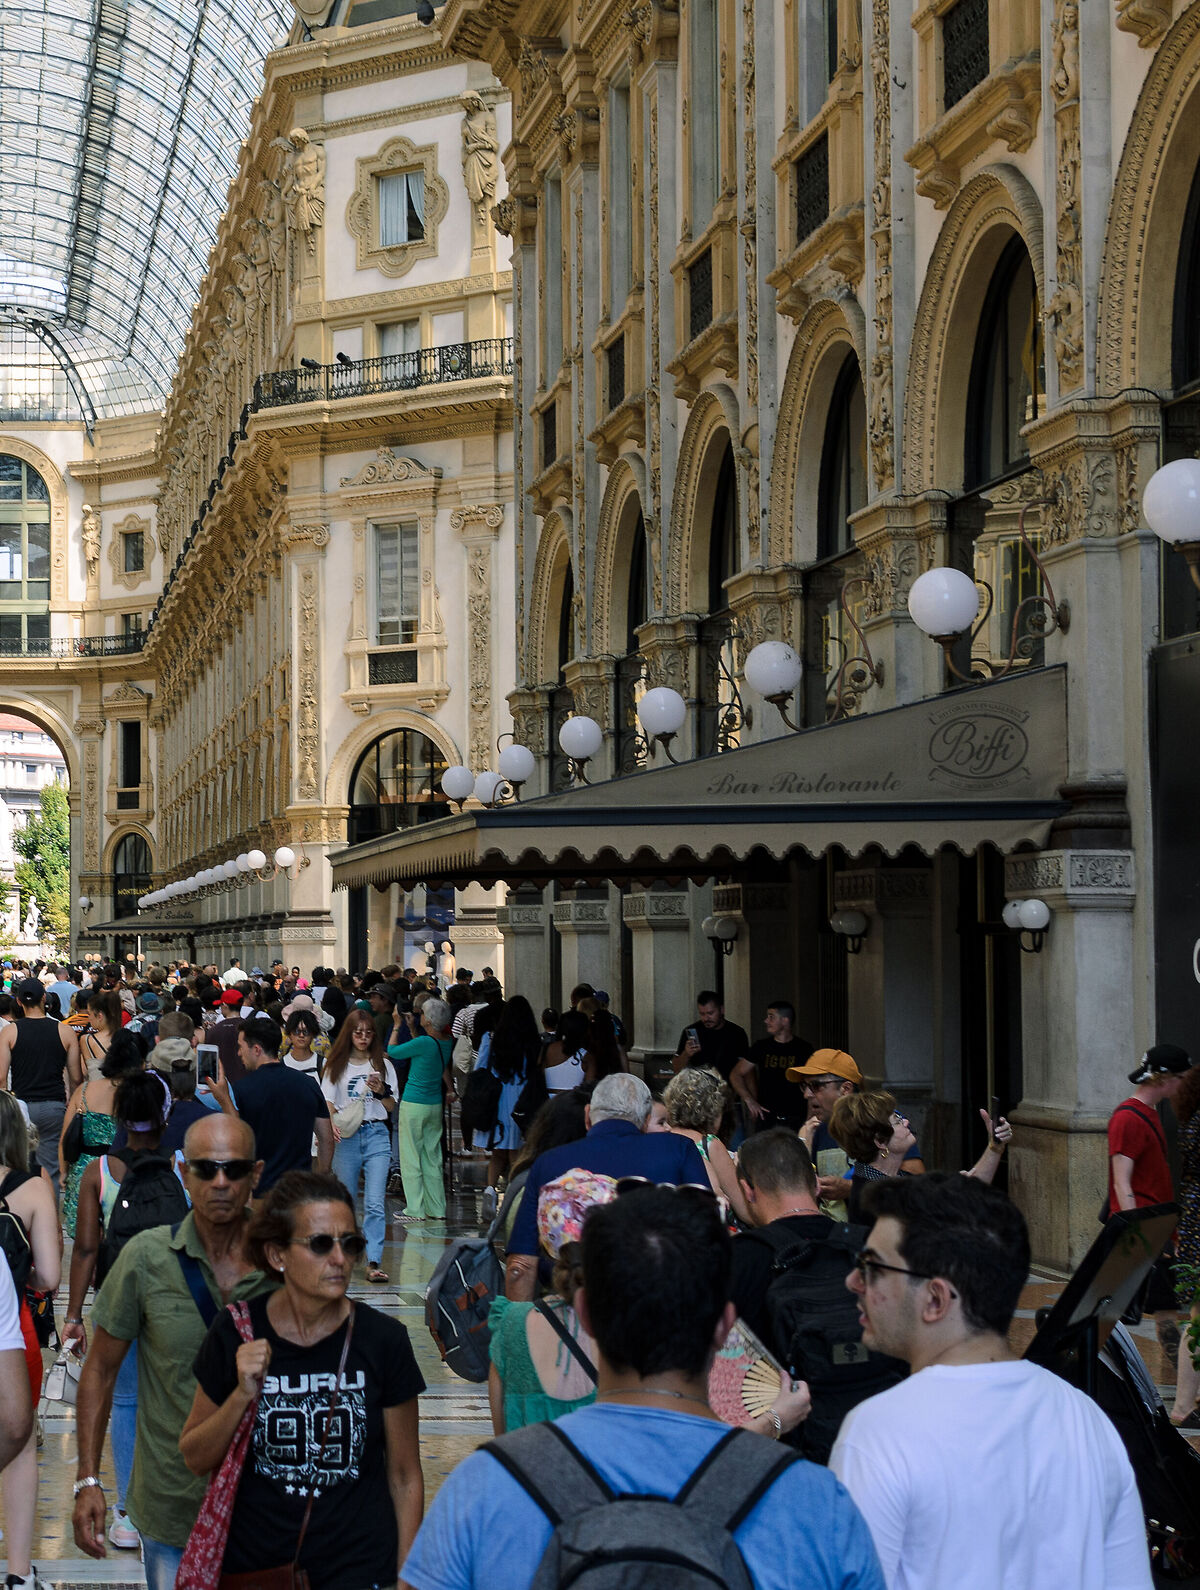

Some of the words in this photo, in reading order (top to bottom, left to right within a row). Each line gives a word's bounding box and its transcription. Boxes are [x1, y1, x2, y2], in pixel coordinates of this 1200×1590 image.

[940, 720, 1015, 775] Biffi
[707, 772, 760, 795] Bar
[769, 771, 901, 794] Ristorante
[117, 887, 149, 895] MONTBLANC
